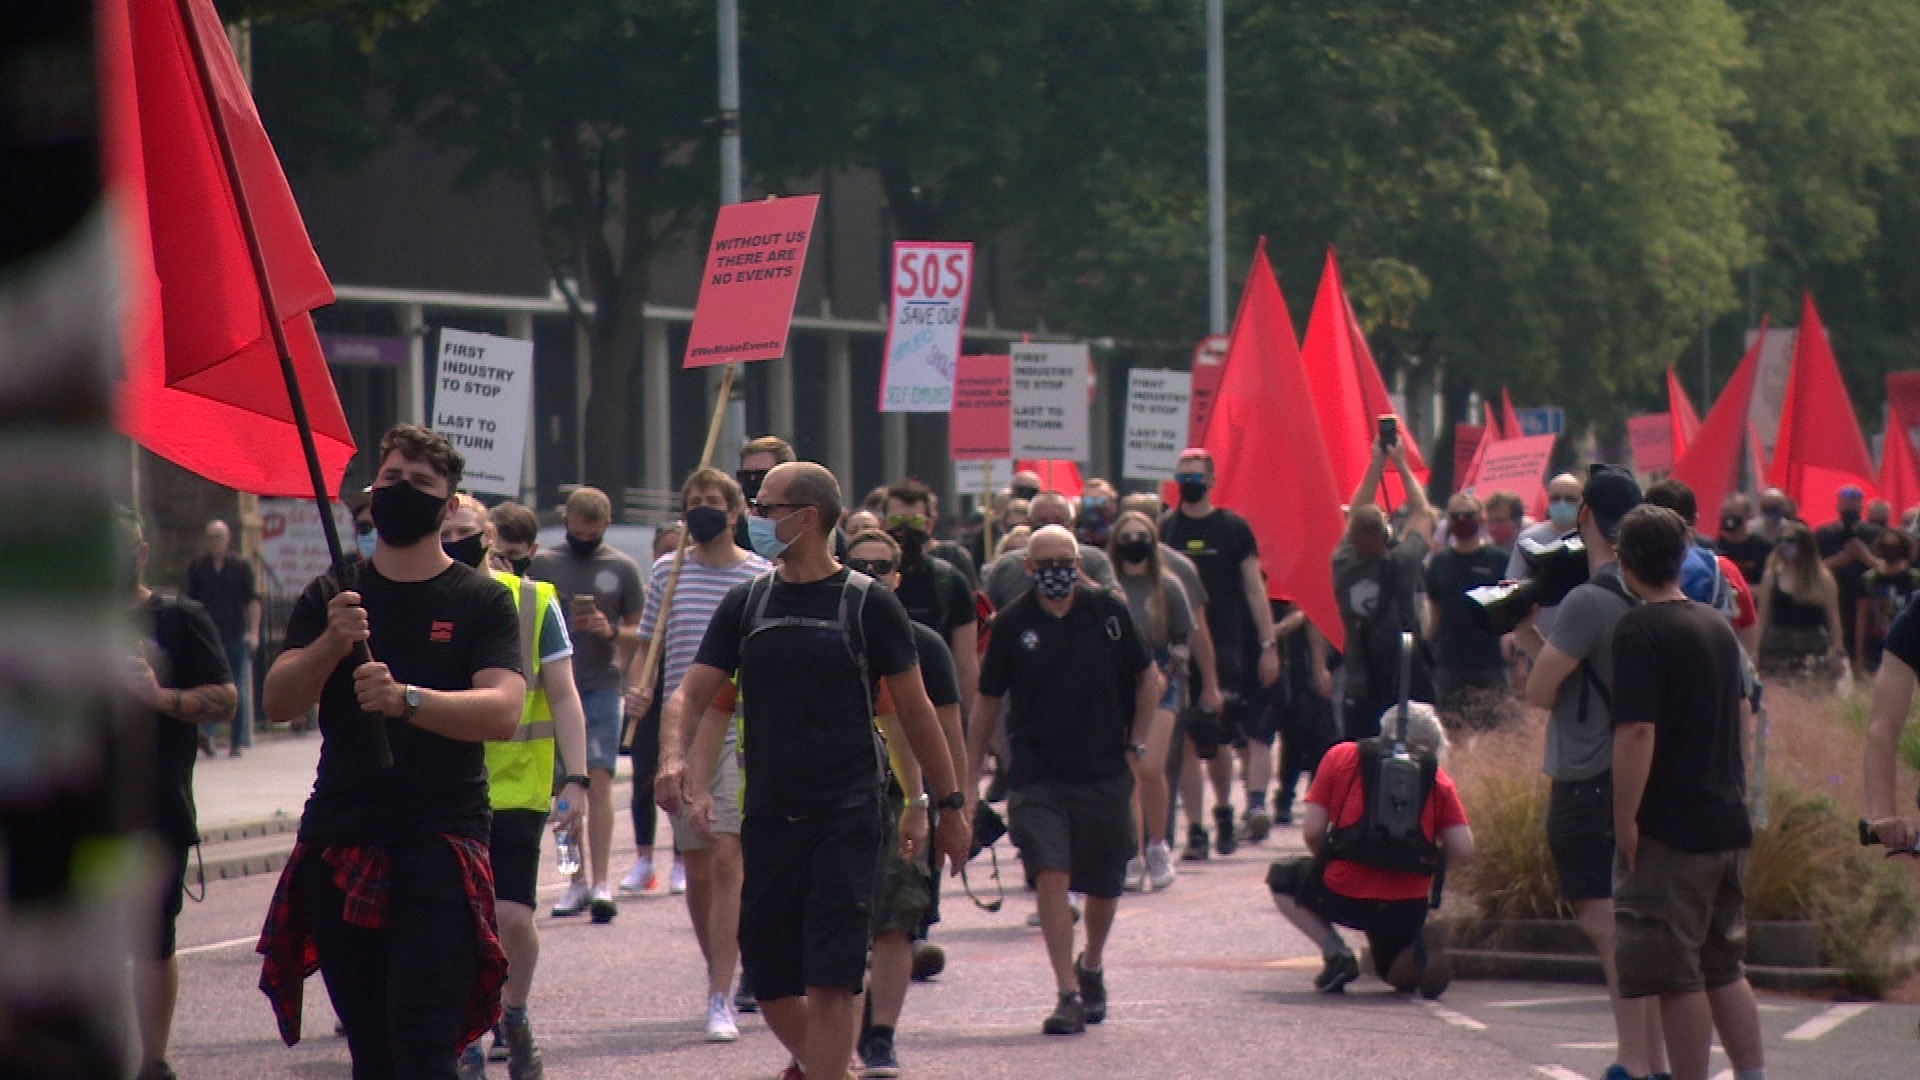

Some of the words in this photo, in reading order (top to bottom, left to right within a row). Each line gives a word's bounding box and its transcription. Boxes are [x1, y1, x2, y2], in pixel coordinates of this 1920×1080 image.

[715, 234, 782, 250] WITHOUT
[785, 231, 806, 242] US
[717, 251, 763, 268] THERE
[766, 248, 797, 262] ARE
[712, 273, 732, 285] NO
[736, 265, 793, 282] EVENTS
[897, 253, 964, 298] SOS
[901, 306, 936, 325] SAVE
[937, 307, 960, 325] OUR
[445, 342, 487, 359] FIRST
[1014, 353, 1048, 362] FIRST
[443, 361, 514, 382] INDUSTRY
[1014, 367, 1074, 376] INDUSTRY
[442, 378, 460, 392] TO
[464, 381, 501, 397] STOP
[1015, 380, 1030, 389] TO
[1033, 380, 1063, 389] STOP
[974, 399, 1010, 408] EVENT
[1014, 406, 1042, 416] LAST
[1047, 406, 1064, 416] TO
[437, 413, 474, 429] LAST
[478, 418, 497, 432] TO
[1014, 420, 1063, 429] RETURN
